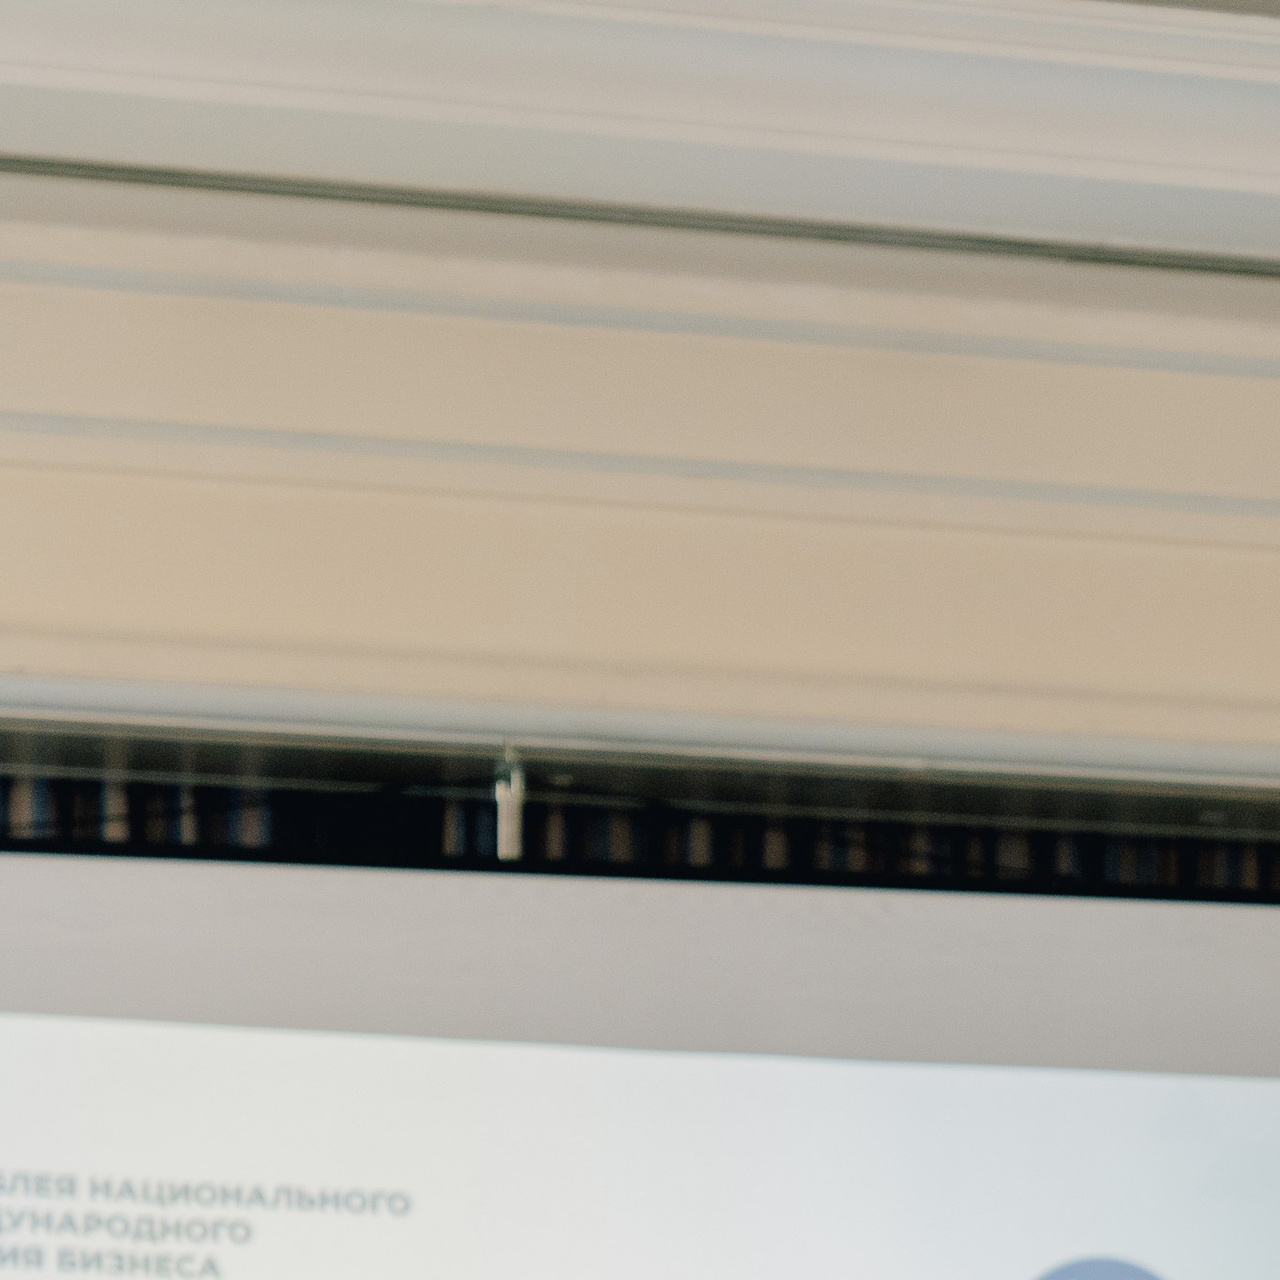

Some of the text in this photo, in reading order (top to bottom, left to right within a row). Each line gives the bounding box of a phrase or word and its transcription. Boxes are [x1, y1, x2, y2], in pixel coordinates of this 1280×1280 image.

[88, 1174, 412, 1217] НАЦИОНАЛЬНОГО
[0, 1208, 254, 1245] УНАРОДНОГО
[57, 1247, 222, 1280] БИЗНЕСА
